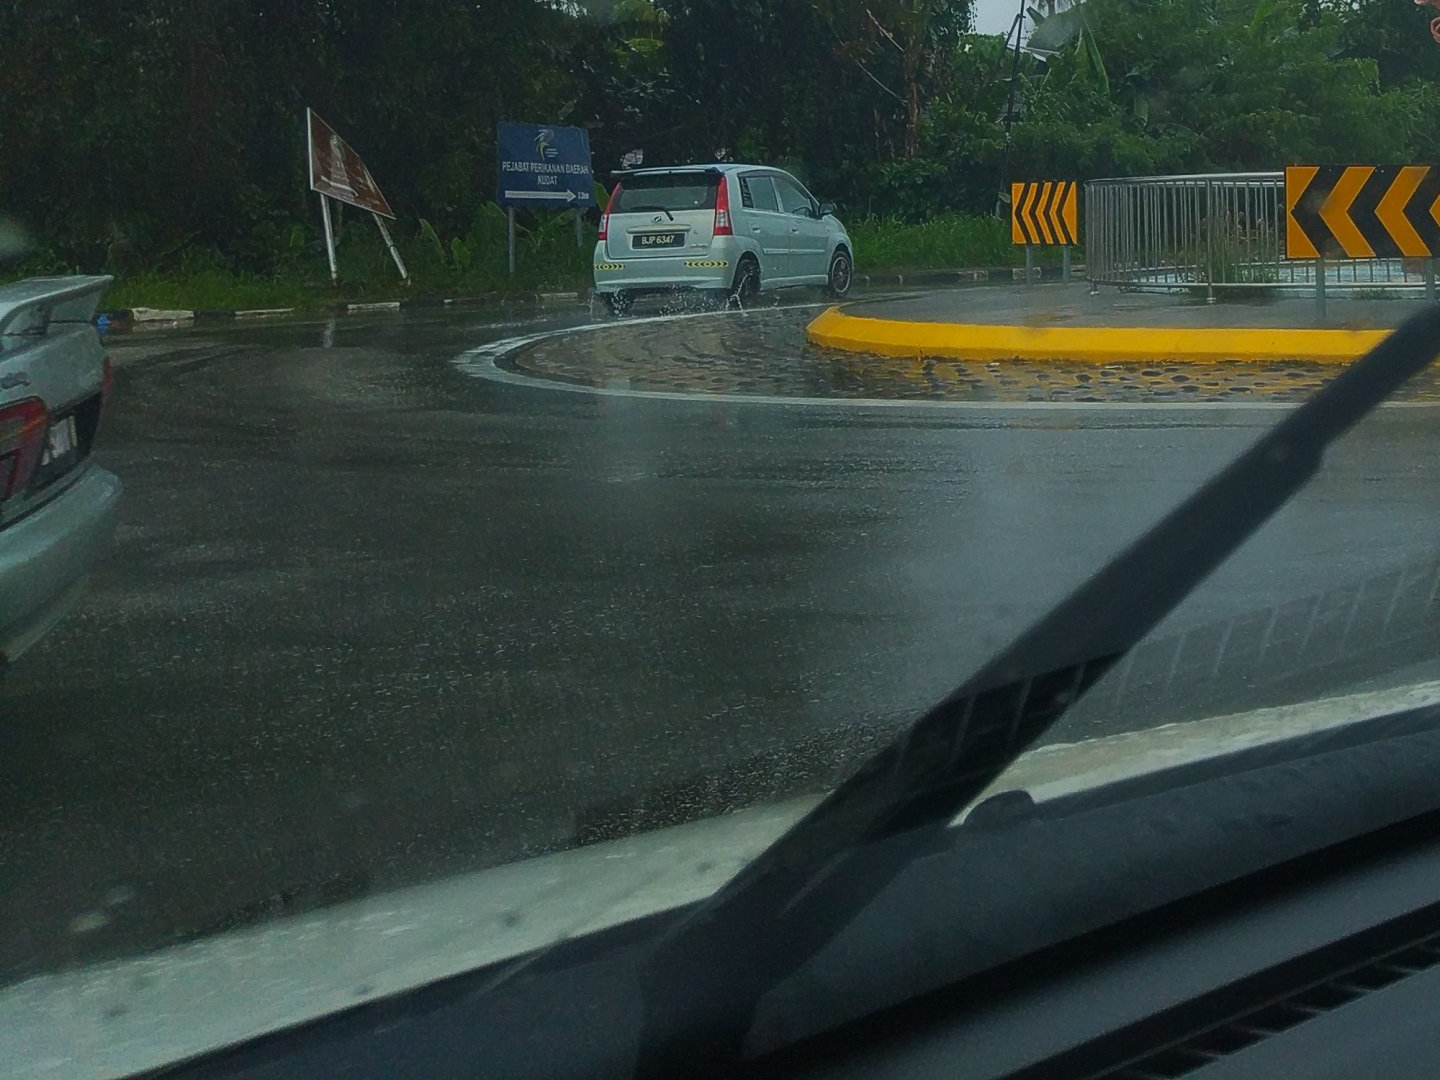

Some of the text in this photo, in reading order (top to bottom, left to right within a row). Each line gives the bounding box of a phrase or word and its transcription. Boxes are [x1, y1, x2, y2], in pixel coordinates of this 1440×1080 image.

[502, 161, 589, 174] PEJABAT PERIKANAN DAERAH
[537, 175, 558, 185] KUDAT
[641, 235, 675, 245] BJP 6347
